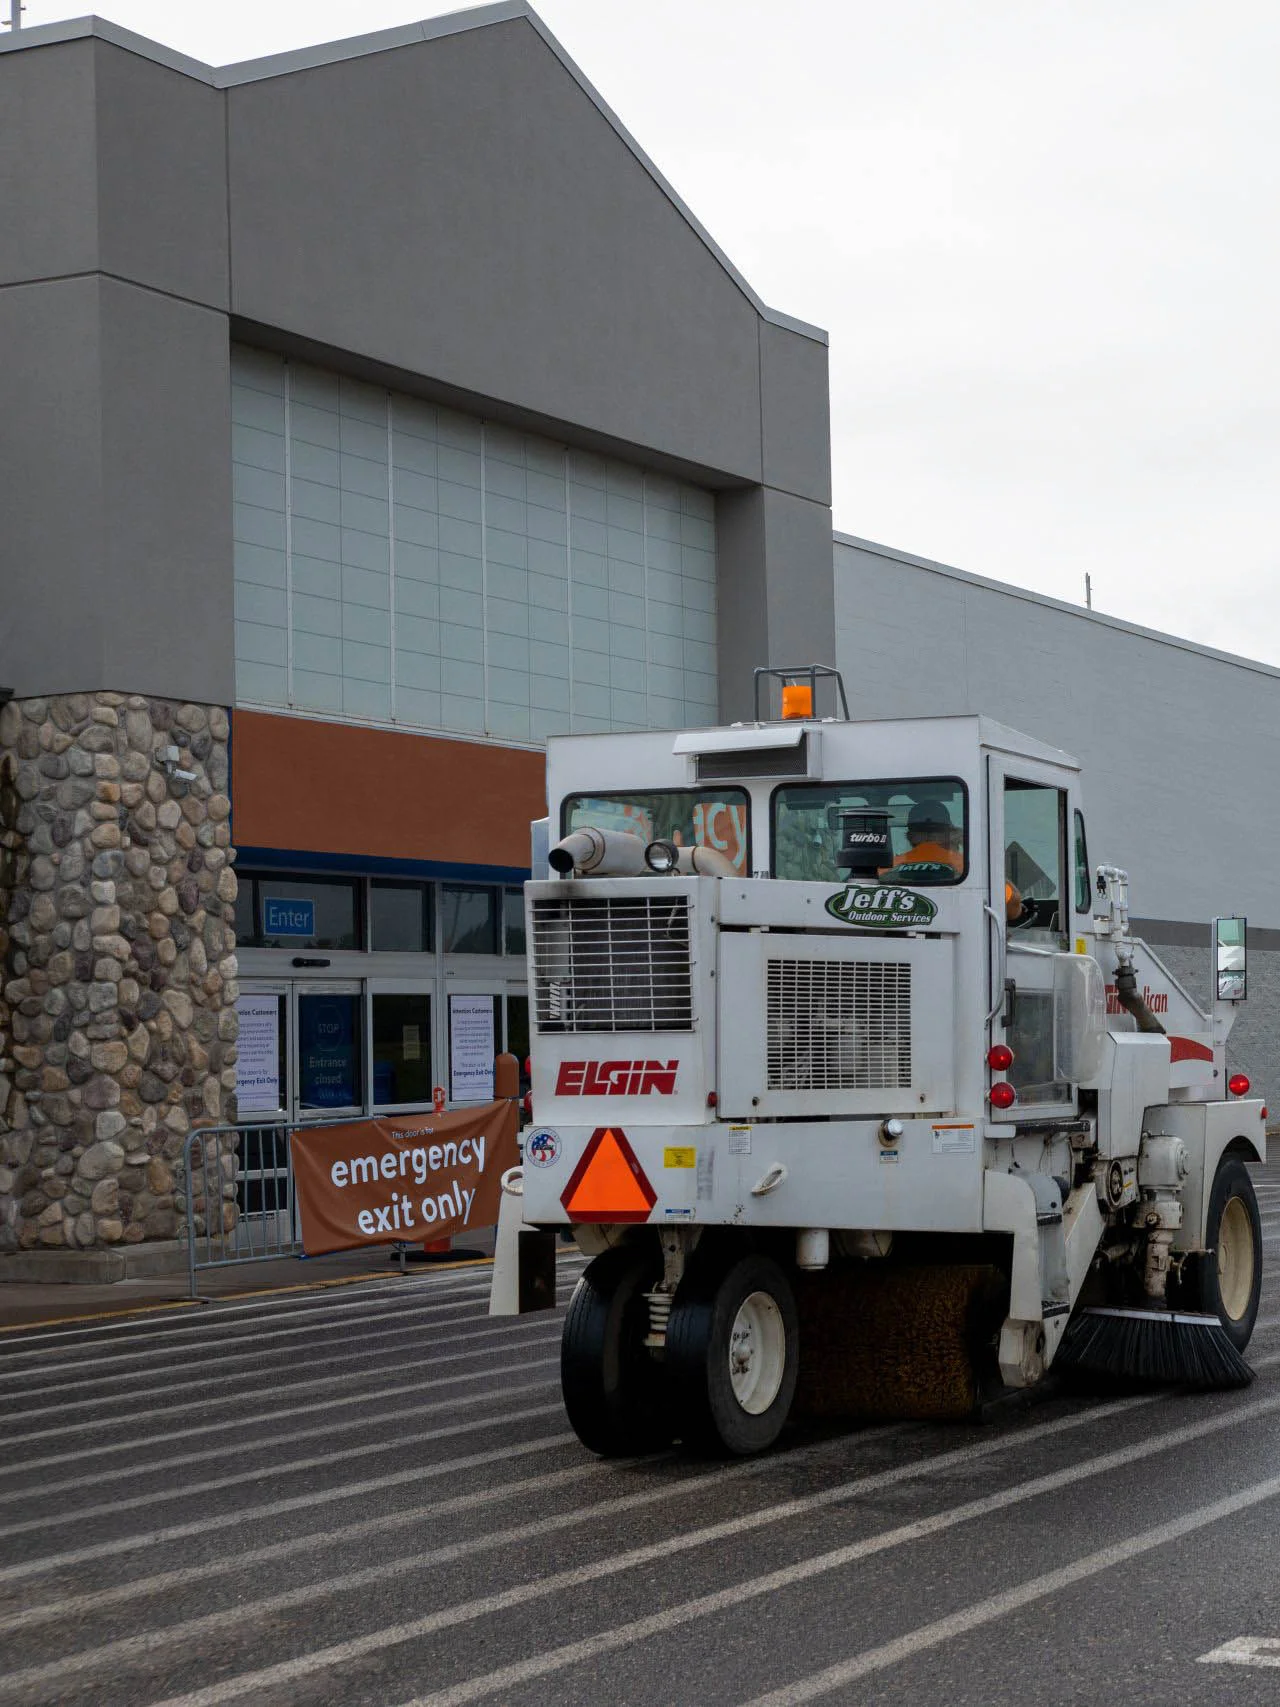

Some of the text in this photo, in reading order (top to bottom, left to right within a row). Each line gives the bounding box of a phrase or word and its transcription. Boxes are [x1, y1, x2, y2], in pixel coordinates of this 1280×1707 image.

[849, 832, 880, 843] turbo
[840, 887, 915, 911] Jeff's
[269, 906, 310, 928] Enter
[848, 911, 931, 923] Outdoor Services
[309, 1056, 347, 1069] Entrance
[314, 1073, 342, 1085] closed
[555, 1060, 679, 1096] ELGIN
[392, 1131, 404, 1139] This
[405, 1129, 419, 1138] door
[331, 1136, 485, 1187] emergency
[358, 1180, 476, 1235] exit only
